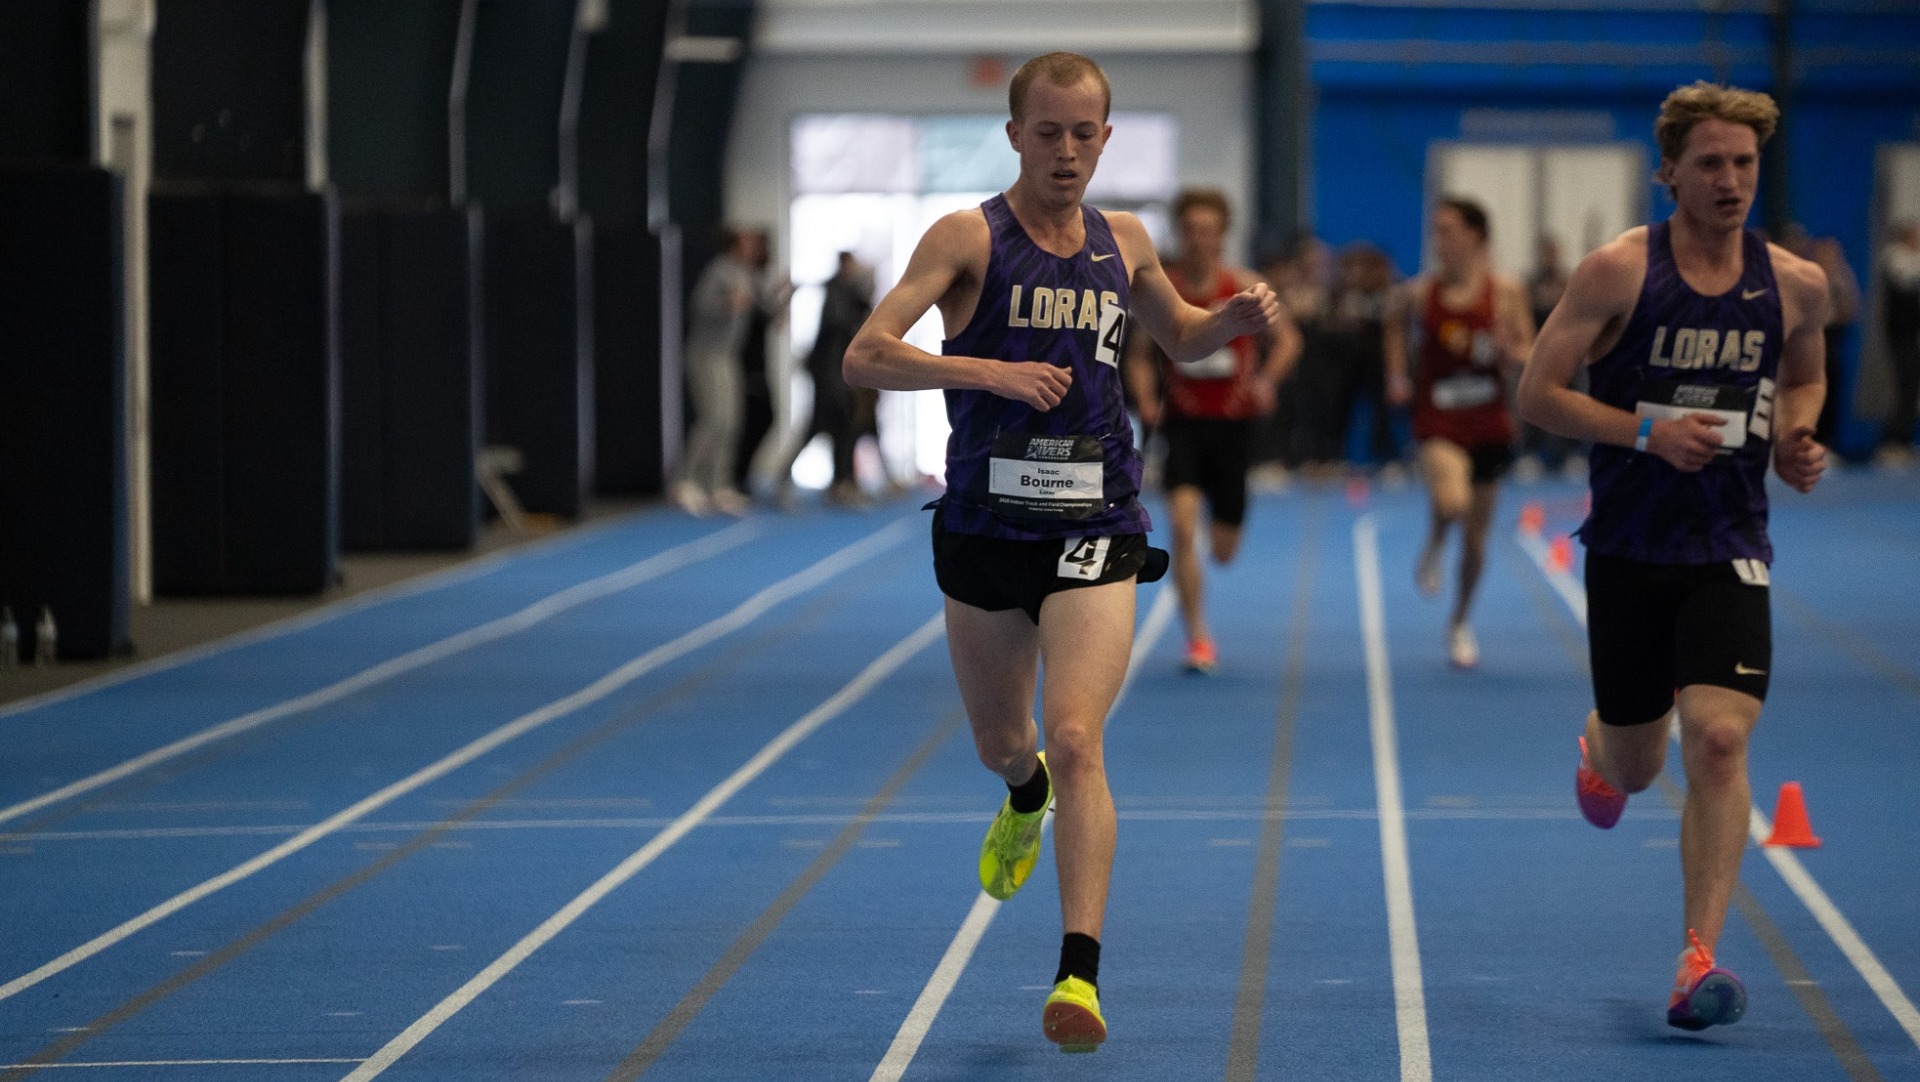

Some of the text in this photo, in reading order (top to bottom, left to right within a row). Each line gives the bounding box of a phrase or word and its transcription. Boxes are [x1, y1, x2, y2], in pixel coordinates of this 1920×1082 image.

[1103, 312, 1125, 363] 4
[1649, 325, 1766, 372] LORAS
[1029, 438, 1075, 447] AMERICAN
[1020, 474, 1074, 488] Bourne
[1037, 467, 1060, 475] Isaac
[1065, 536, 1098, 575] 4
